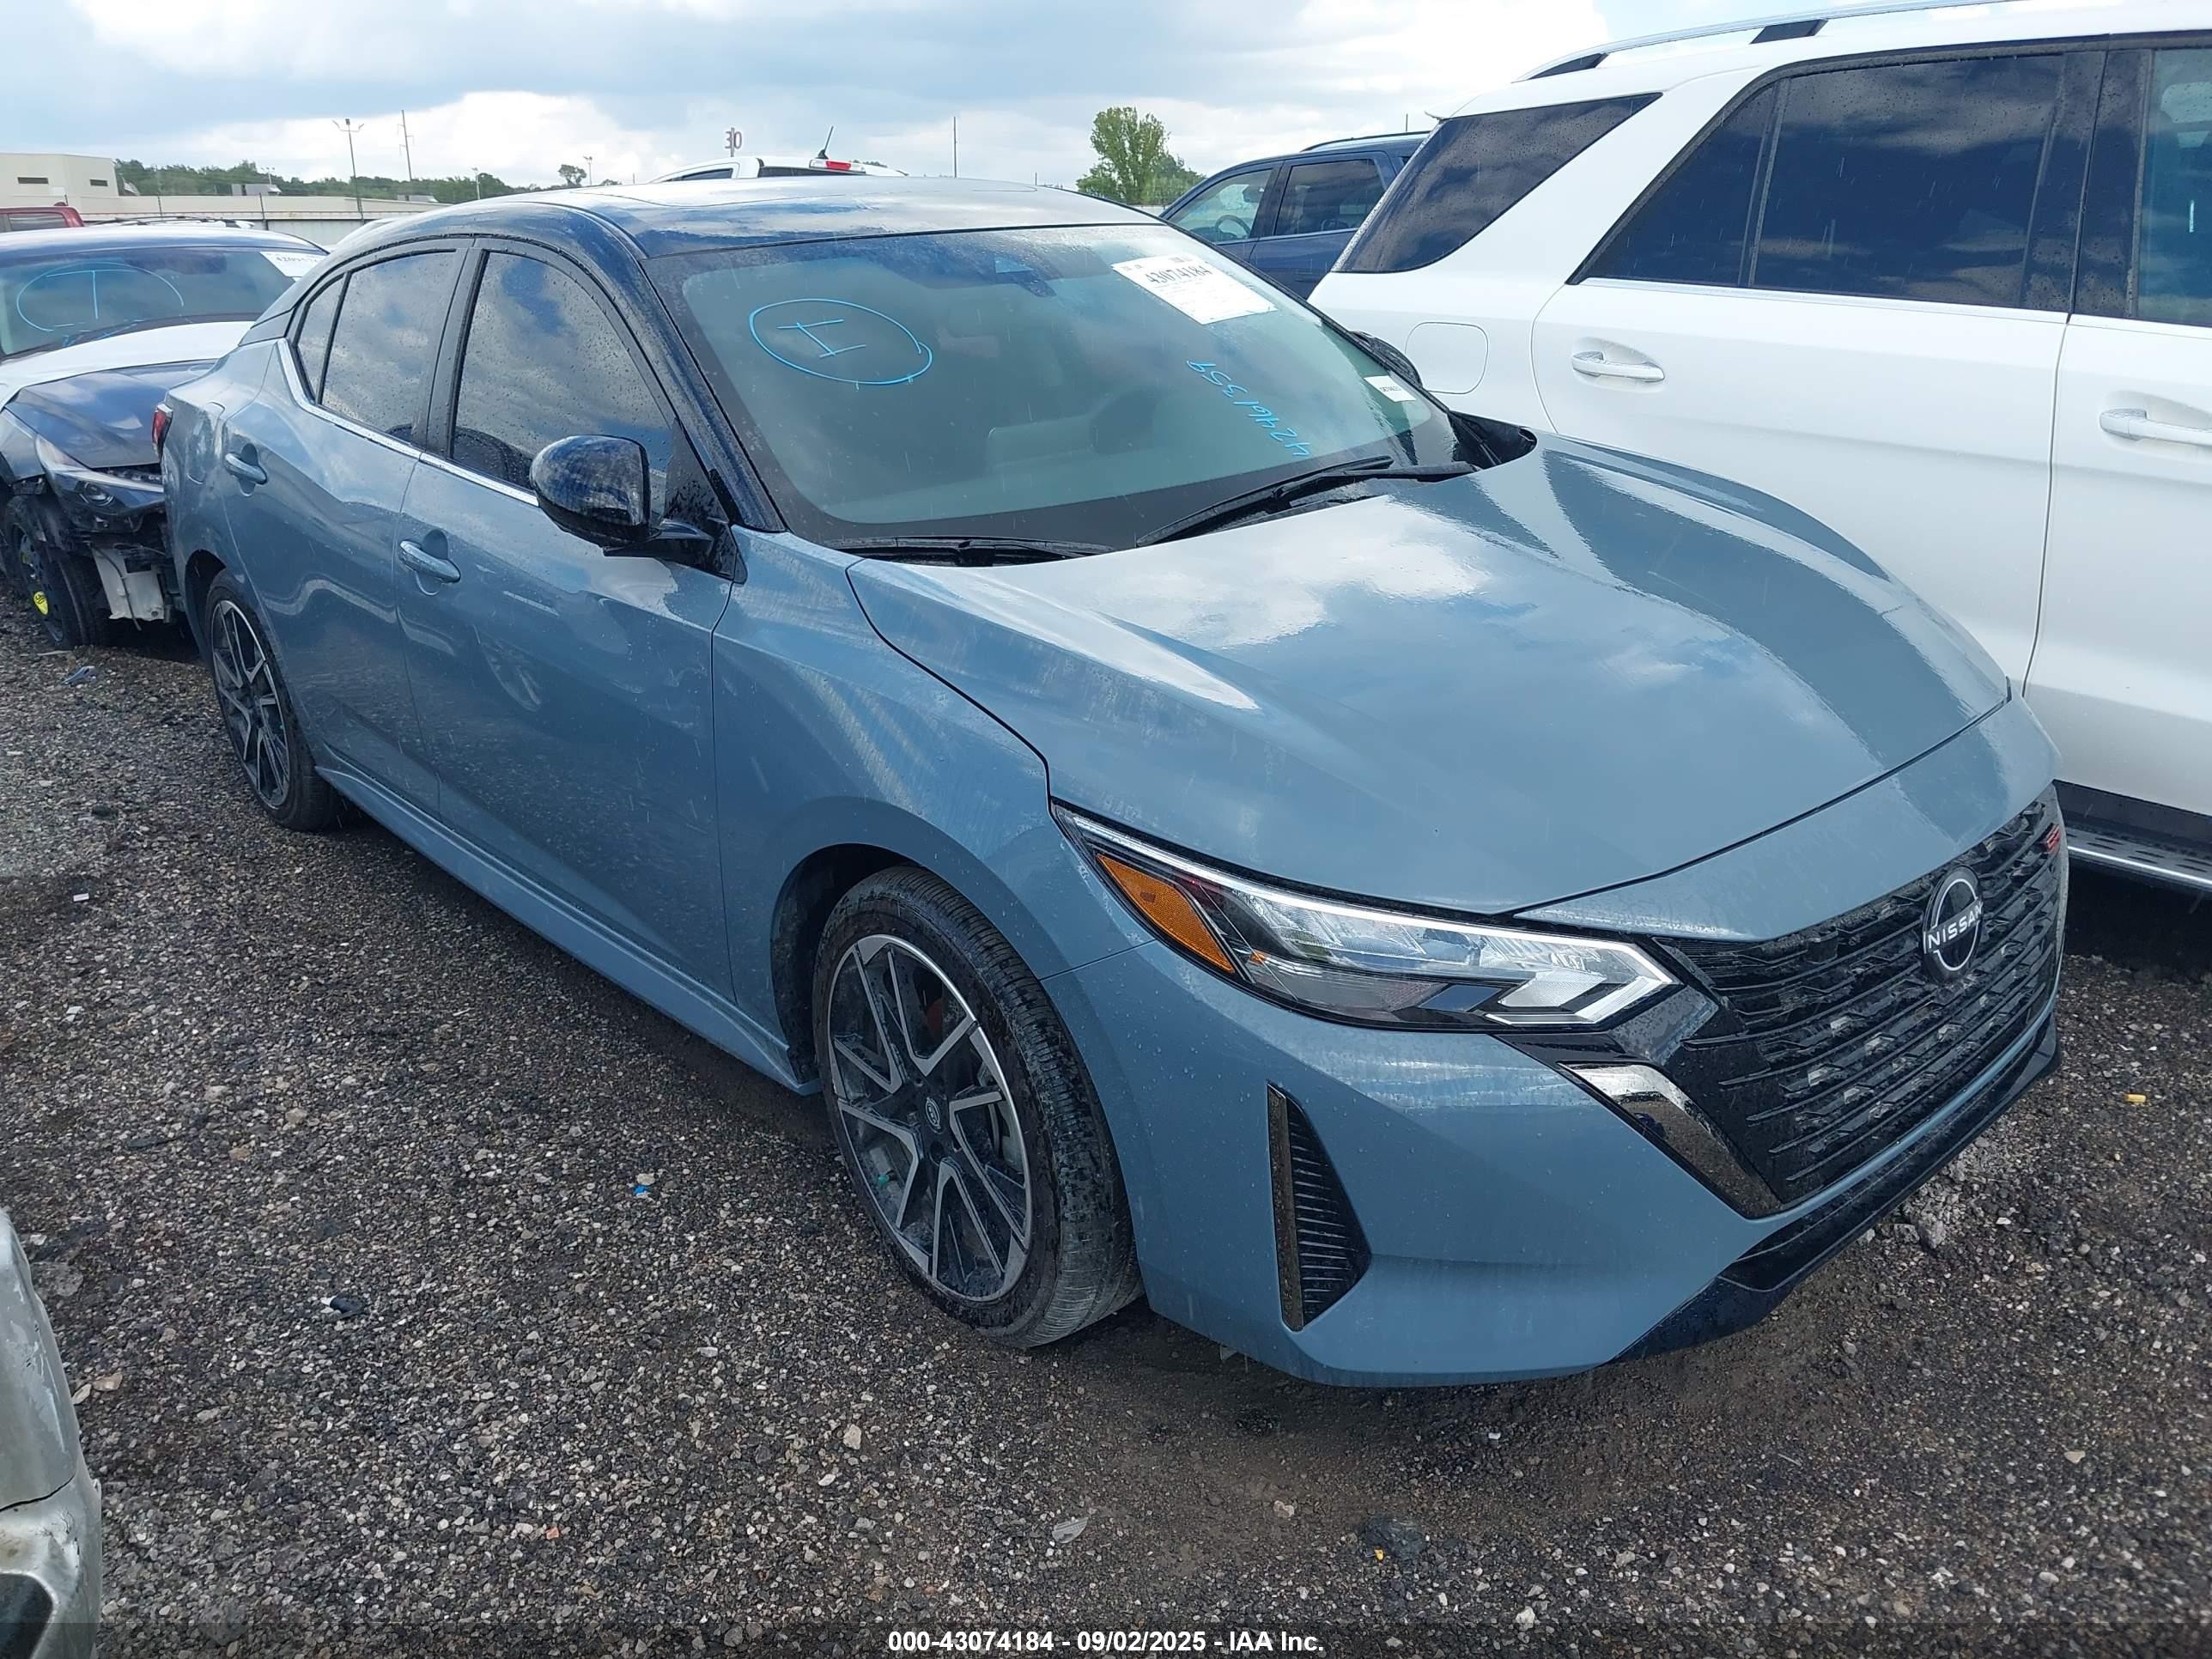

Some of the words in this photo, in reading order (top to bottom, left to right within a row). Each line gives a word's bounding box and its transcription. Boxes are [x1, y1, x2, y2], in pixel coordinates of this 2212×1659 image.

[724, 131, 743, 149] 30
[1146, 264, 1213, 283] 43074184
[1927, 901, 1984, 949] NISSAN
